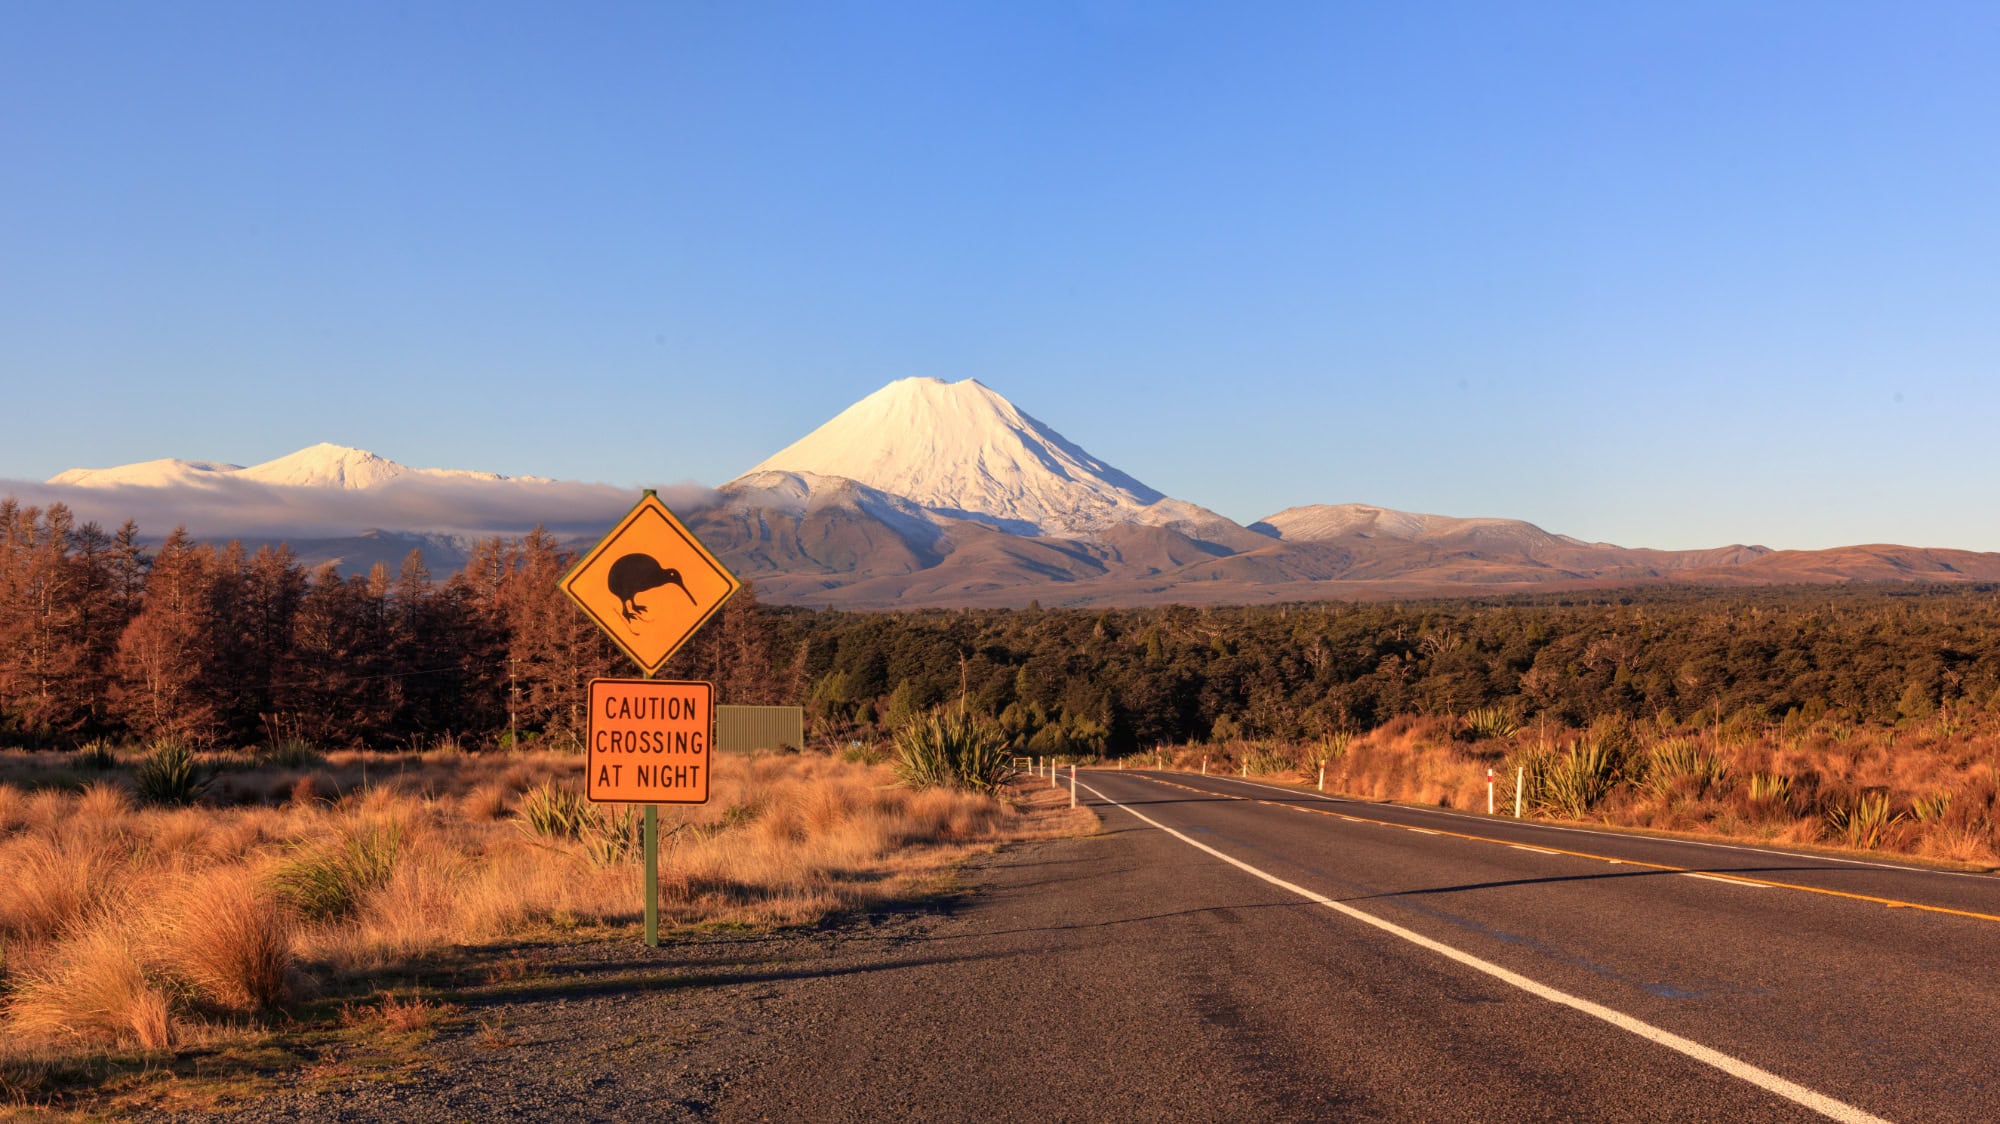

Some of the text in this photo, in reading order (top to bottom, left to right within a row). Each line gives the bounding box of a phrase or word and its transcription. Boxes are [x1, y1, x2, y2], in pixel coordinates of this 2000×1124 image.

[605, 696, 696, 720] CAUTION
[595, 730, 703, 754] CROSSING
[598, 764, 700, 788] AT NIGHT
